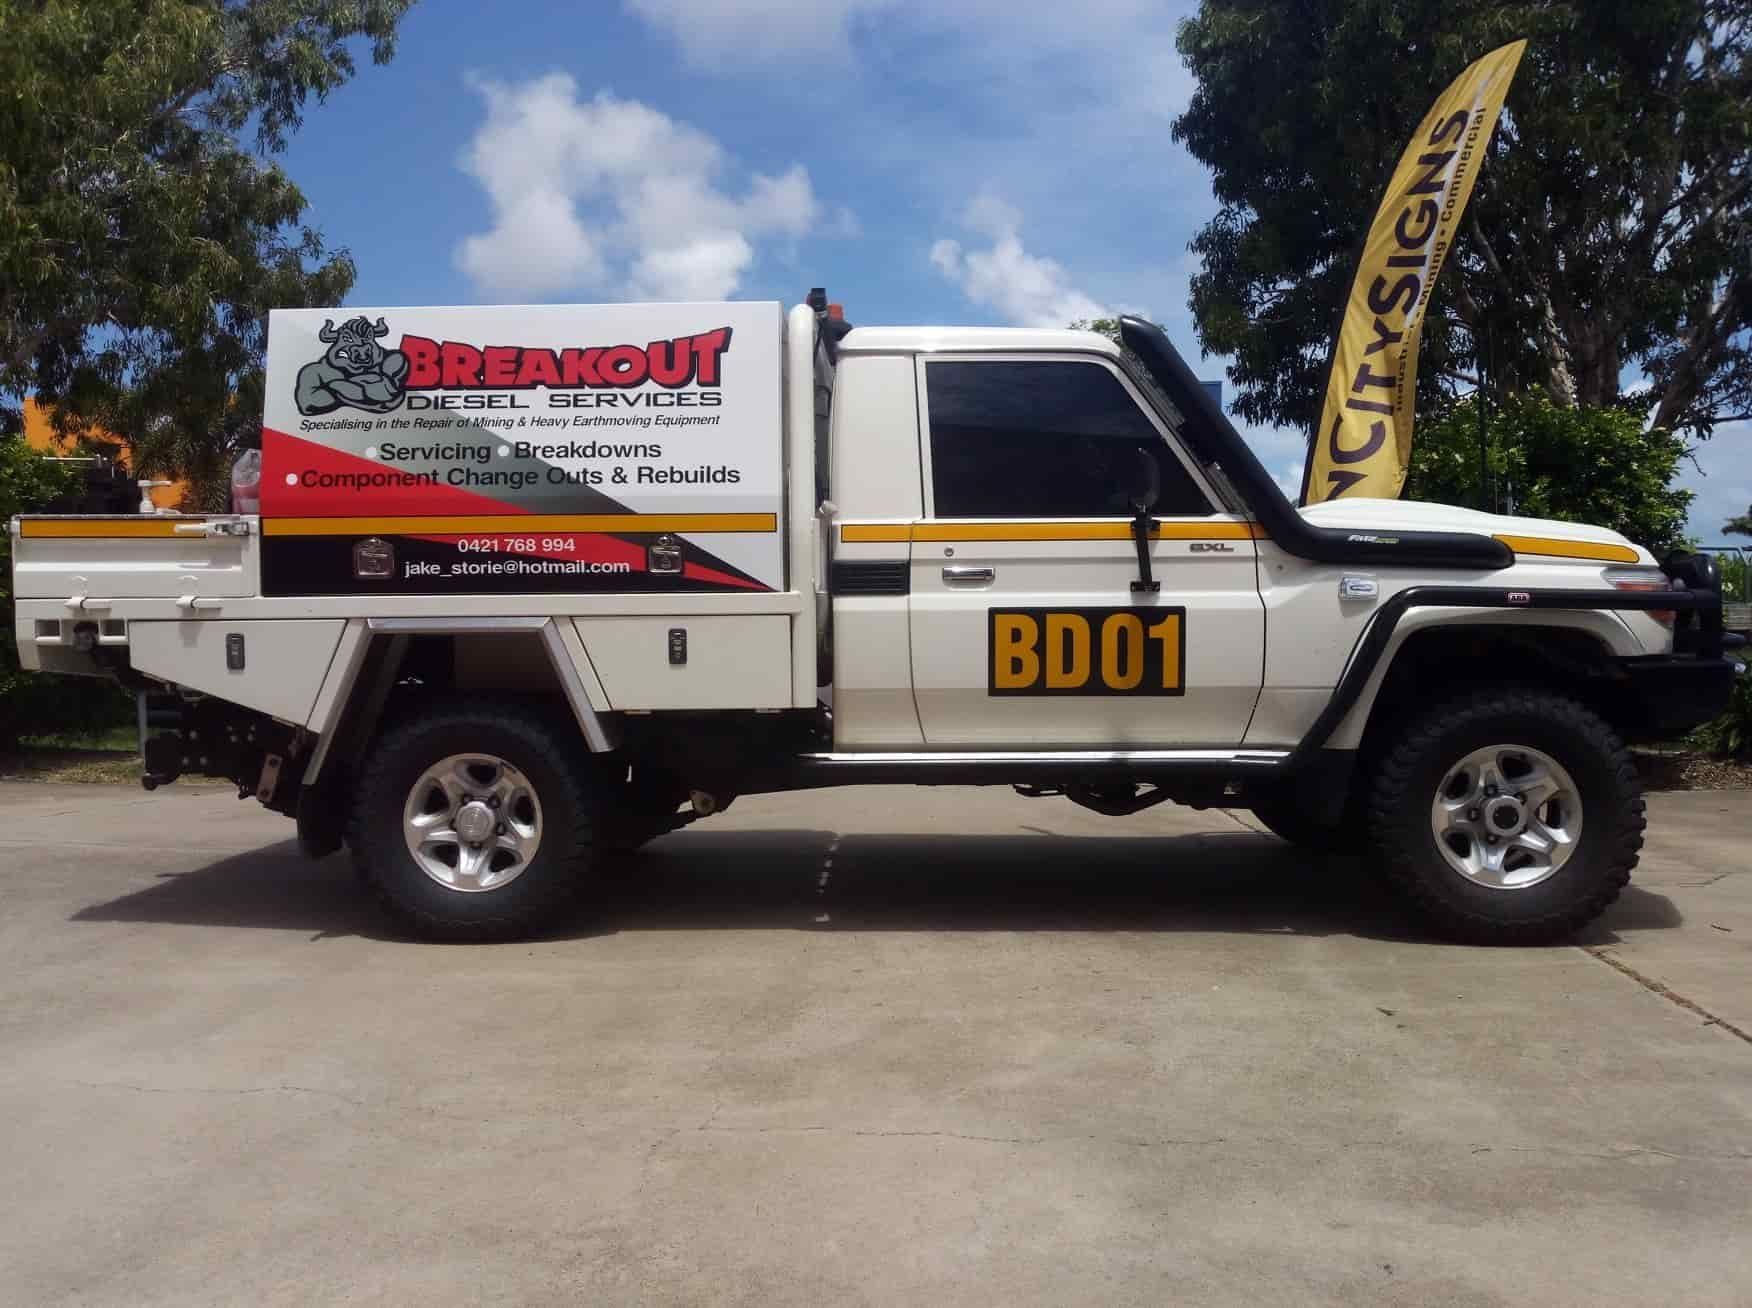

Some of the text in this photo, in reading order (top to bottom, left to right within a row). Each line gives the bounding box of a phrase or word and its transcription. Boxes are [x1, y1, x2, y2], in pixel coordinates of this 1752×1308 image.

[1441, 107, 1487, 222] Commercial
[401, 325, 733, 391] BREAKOUT
[406, 391, 723, 411] DIESEL SERVICES
[299, 414, 721, 432] Specialising in the Repair of Mining & Heavy Earthmoving Equipment
[380, 440, 662, 463] Servicing Breakdowns
[301, 465, 741, 491] Component Change Outs & Rebuilds
[457, 538, 576, 553] 0421 768 994
[404, 560, 631, 579] jake_storie@hotmail.com
